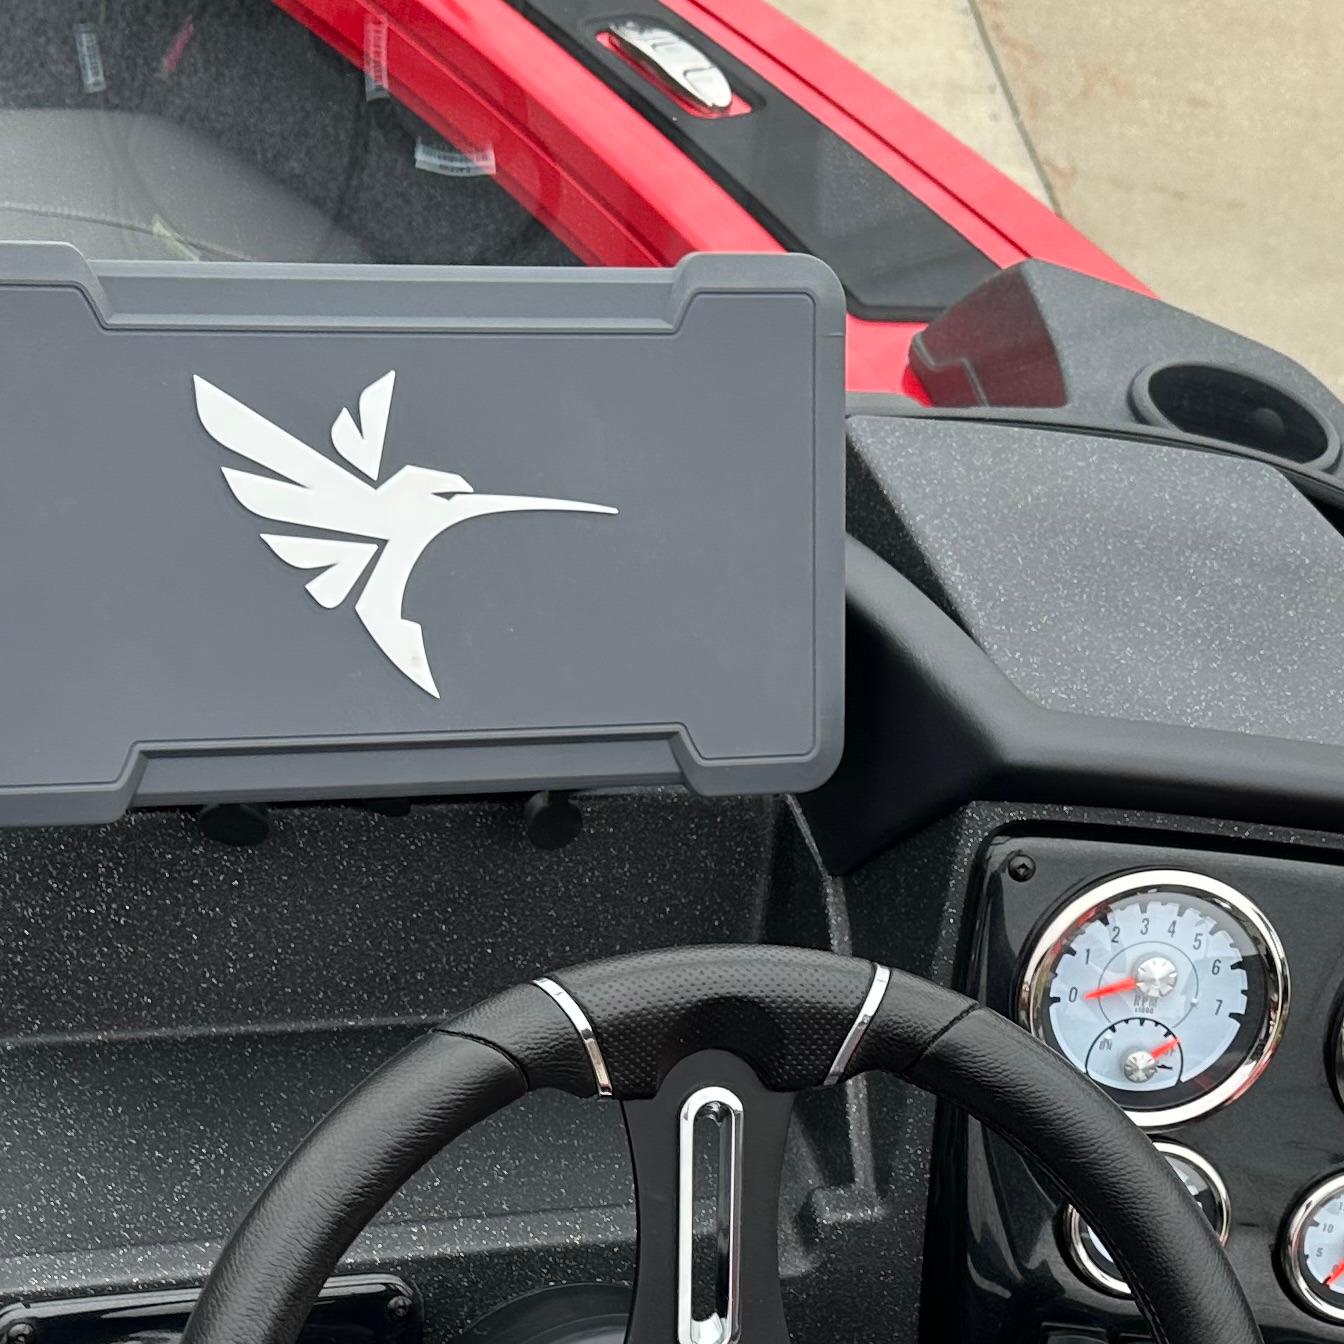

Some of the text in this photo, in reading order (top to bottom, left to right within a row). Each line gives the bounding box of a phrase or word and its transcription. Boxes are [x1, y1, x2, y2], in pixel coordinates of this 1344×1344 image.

[1111, 926, 1121, 943] 2
[1140, 918, 1150, 935] 3
[1167, 920, 1177, 937] 4
[1193, 933, 1203, 950] 5
[1083, 949, 1091, 965] 1
[1211, 959, 1222, 975] 6
[1069, 987, 1078, 1002] 0
[1214, 999, 1223, 1016] 7
[1322, 1223, 1334, 1233] 10
[1316, 1248, 1323, 1257] 5
